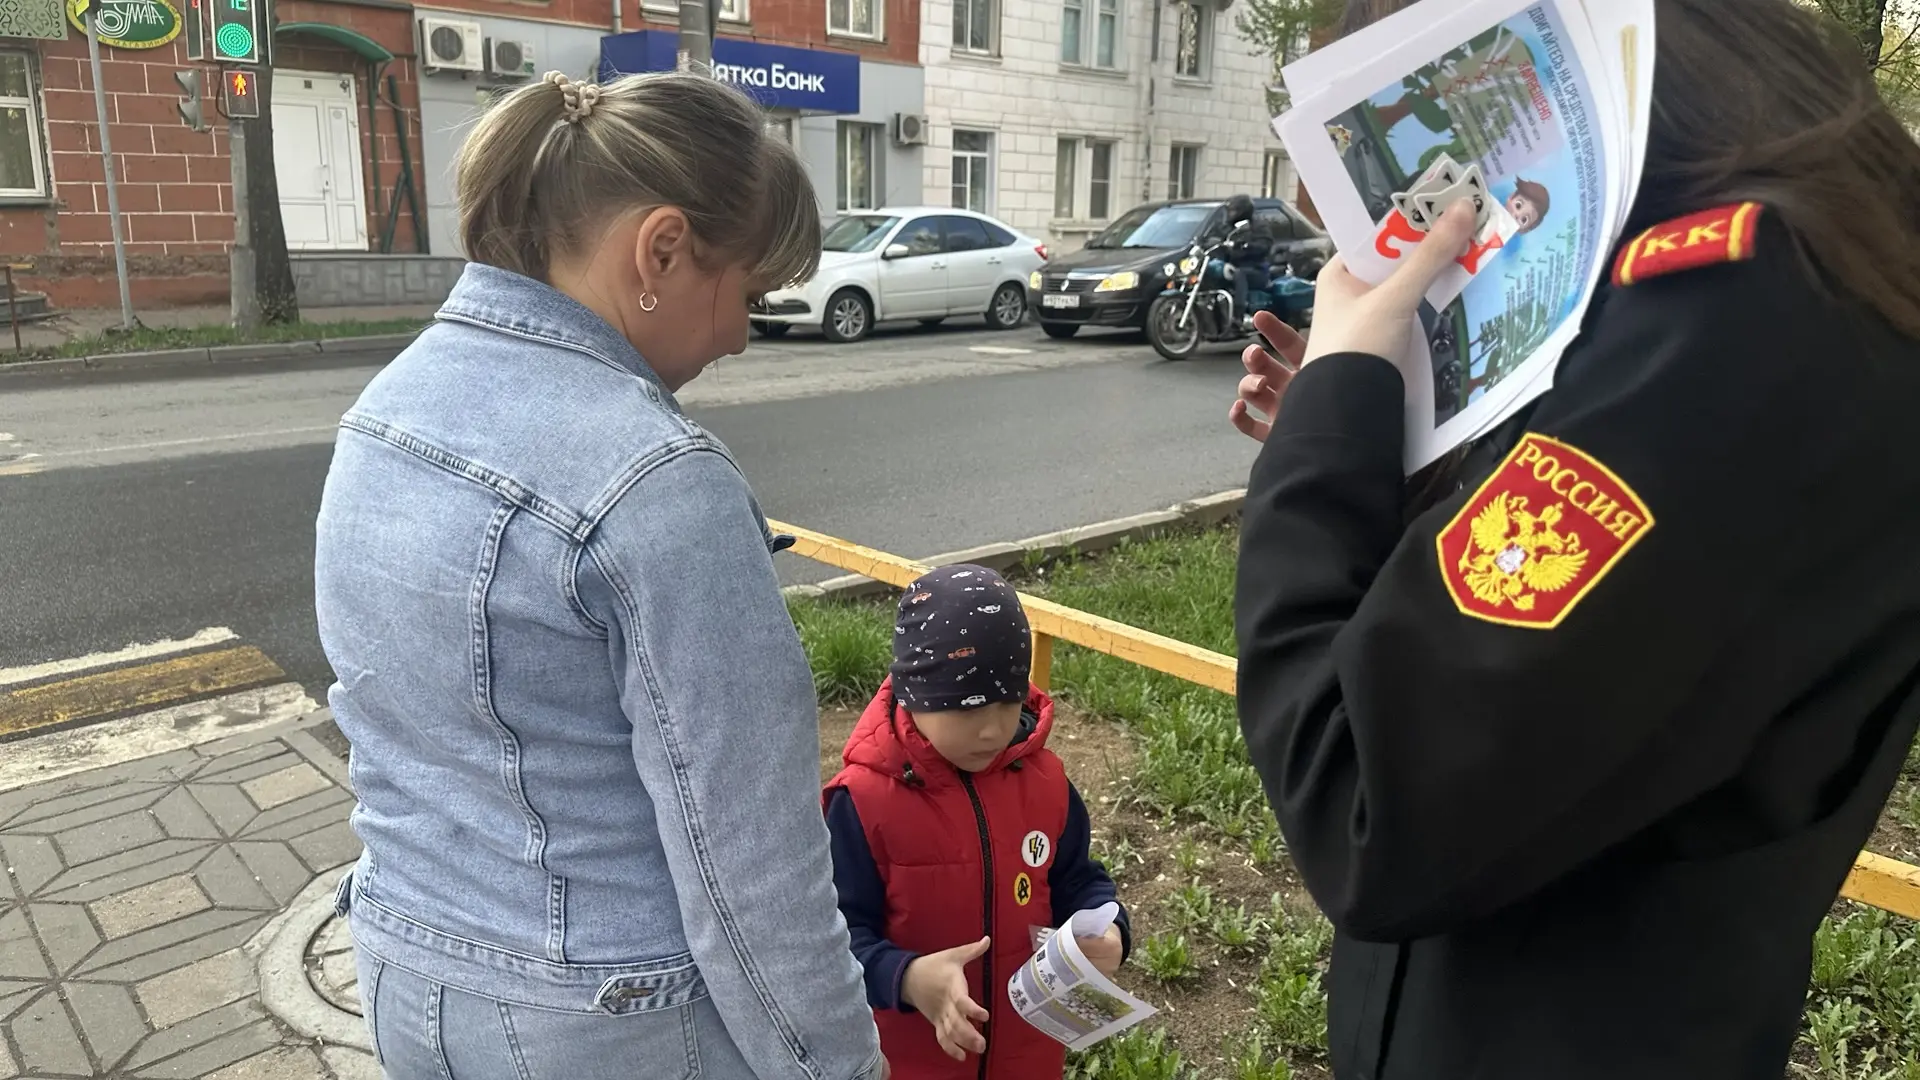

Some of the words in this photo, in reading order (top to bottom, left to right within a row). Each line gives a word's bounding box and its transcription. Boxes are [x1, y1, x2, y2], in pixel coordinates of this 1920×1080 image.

[710, 58, 767, 88] ятка
[771, 63, 825, 93] Банк
[1558, 68, 1573, 85] НА
[1640, 219, 1727, 258] КК
[1515, 442, 1643, 540] РОССИЯ
